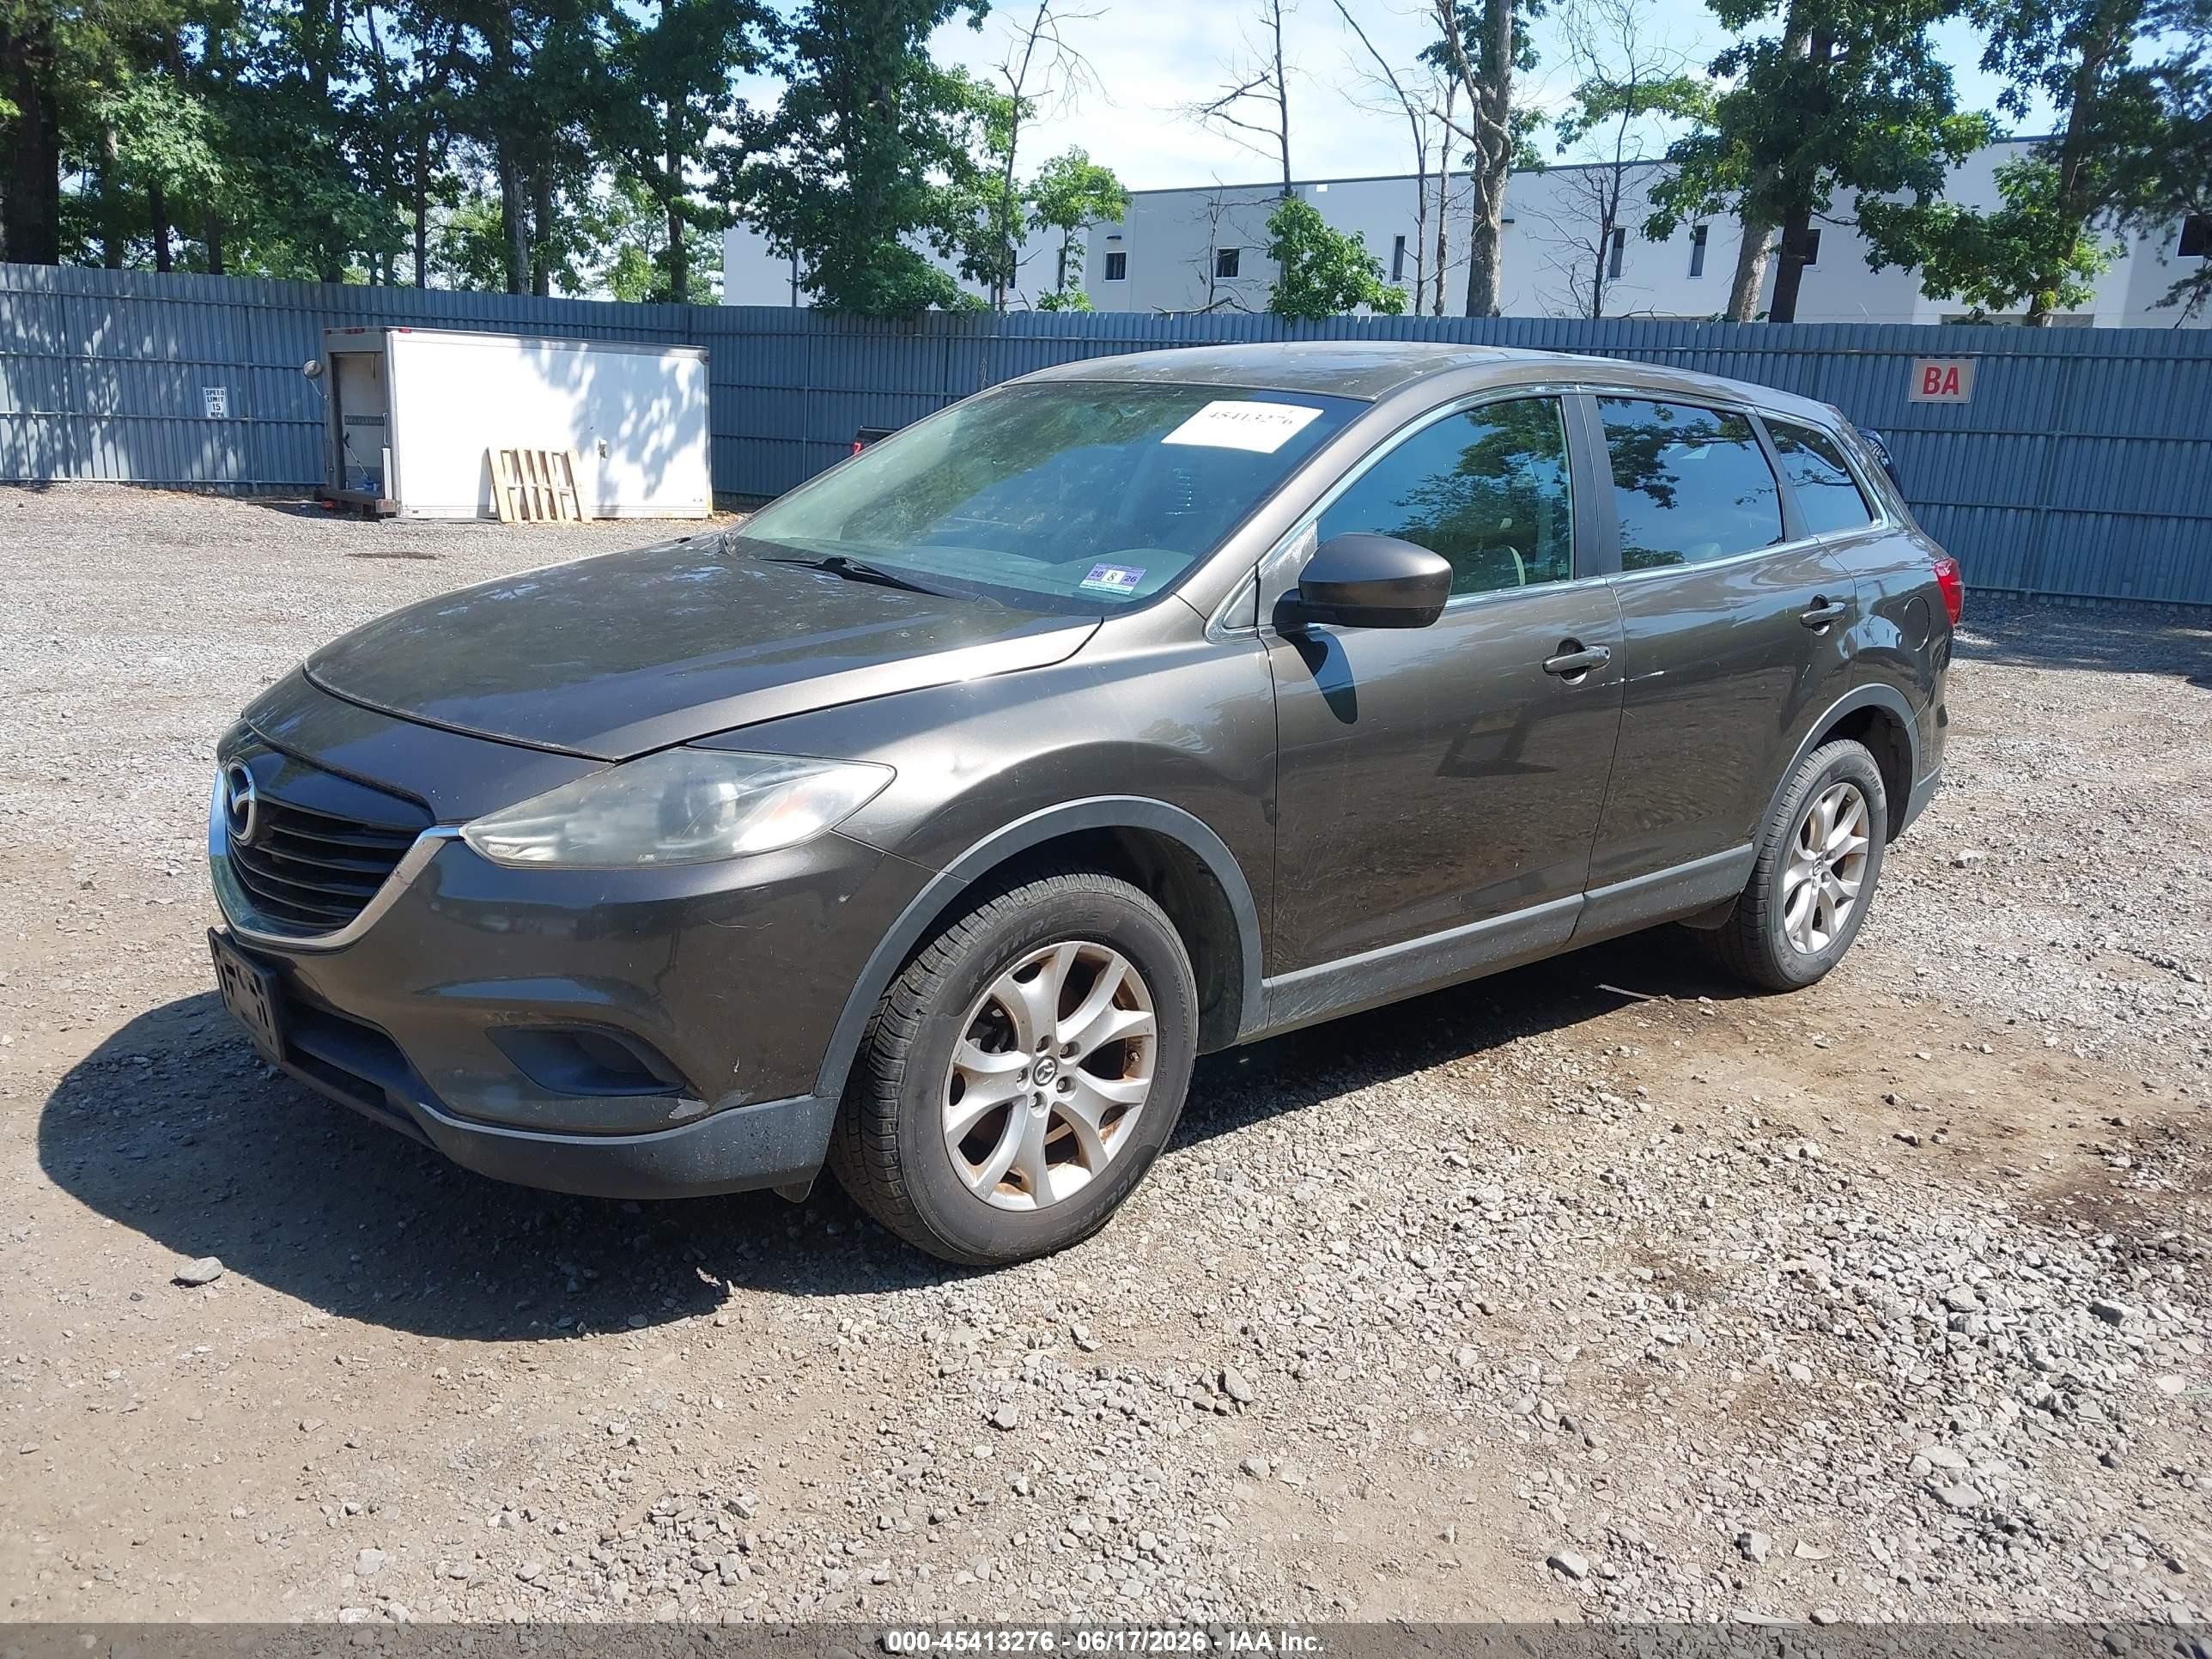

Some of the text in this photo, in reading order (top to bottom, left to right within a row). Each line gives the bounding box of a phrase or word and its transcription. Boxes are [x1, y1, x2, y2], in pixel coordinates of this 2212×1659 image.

[1923, 367, 1959, 395] BA
[212, 403, 222, 411] 15
[1091, 570, 1103, 579] 20
[1107, 572, 1118, 581] 8
